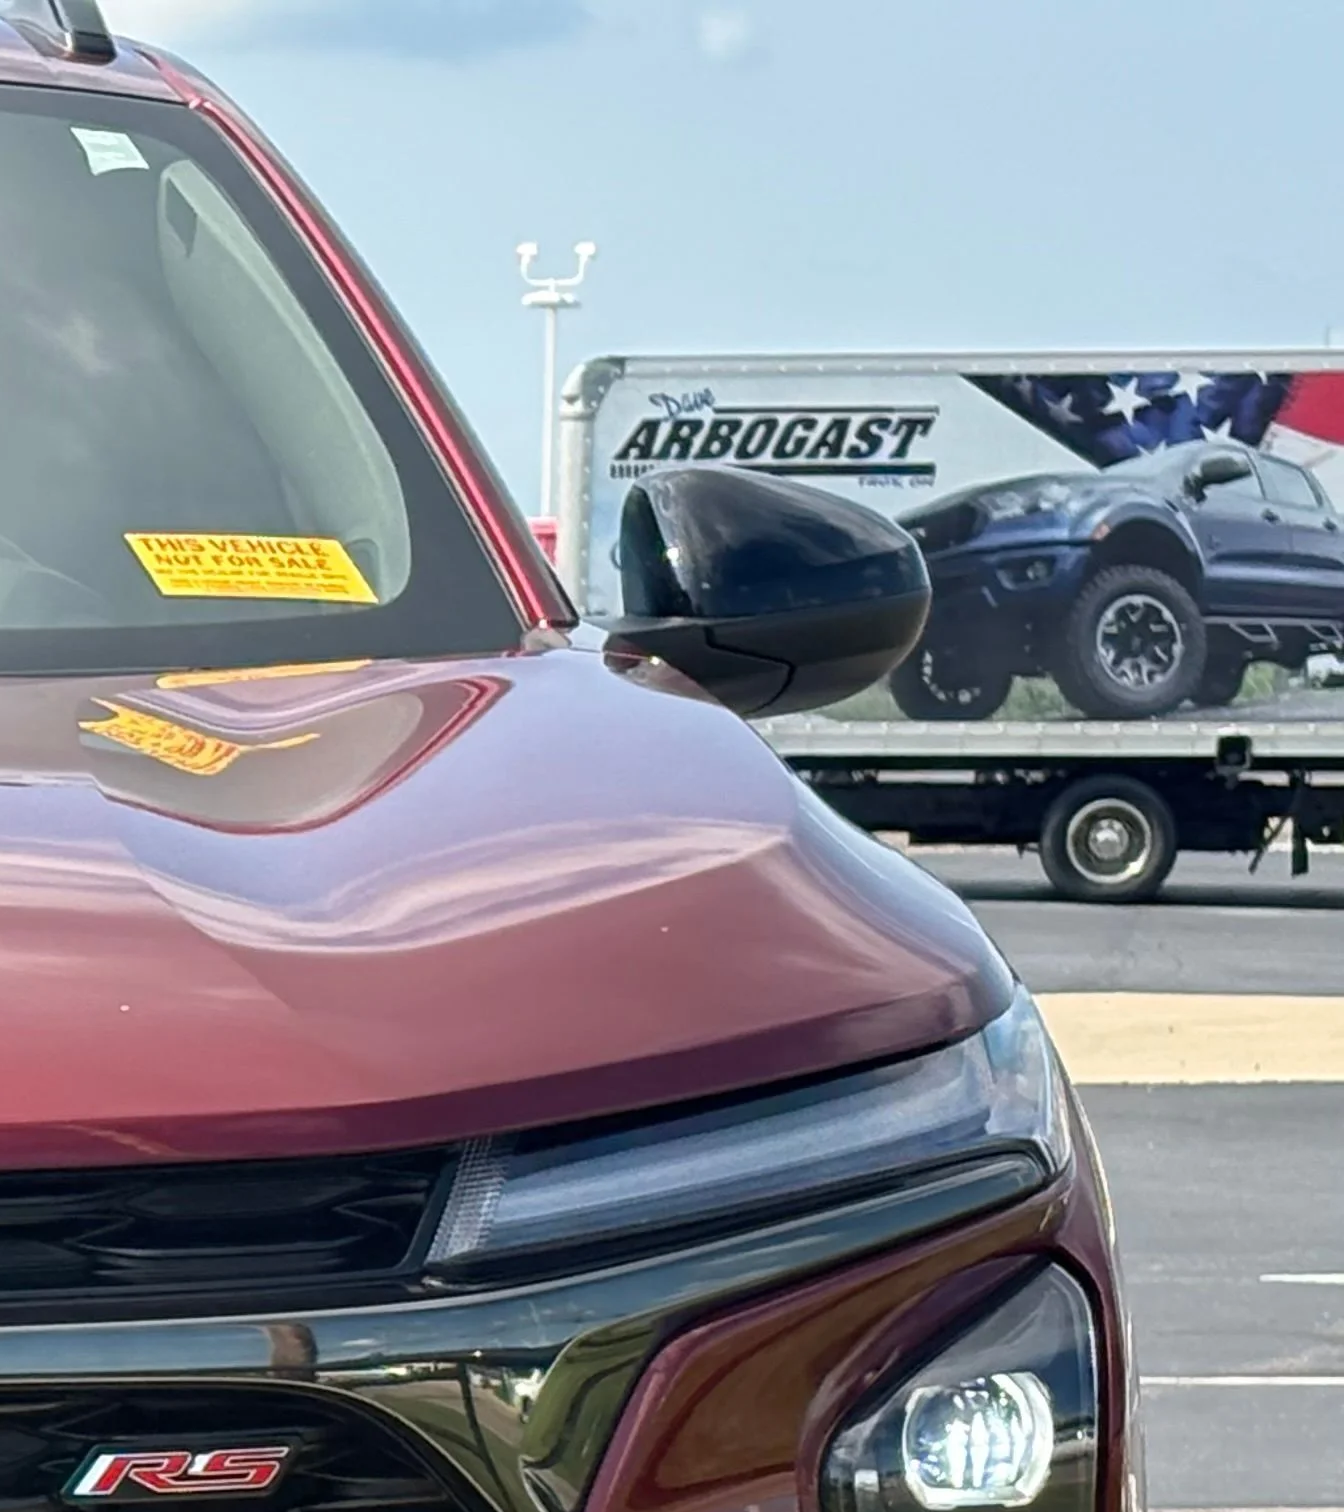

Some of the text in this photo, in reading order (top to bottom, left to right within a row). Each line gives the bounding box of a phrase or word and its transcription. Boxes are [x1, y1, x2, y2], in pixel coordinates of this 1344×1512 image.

[614, 415, 936, 461] ARBOGAST
[138, 537, 330, 557] THIS VEHICLE
[154, 553, 332, 571] NOT FOR SALE
[73, 1446, 290, 1496] RS
